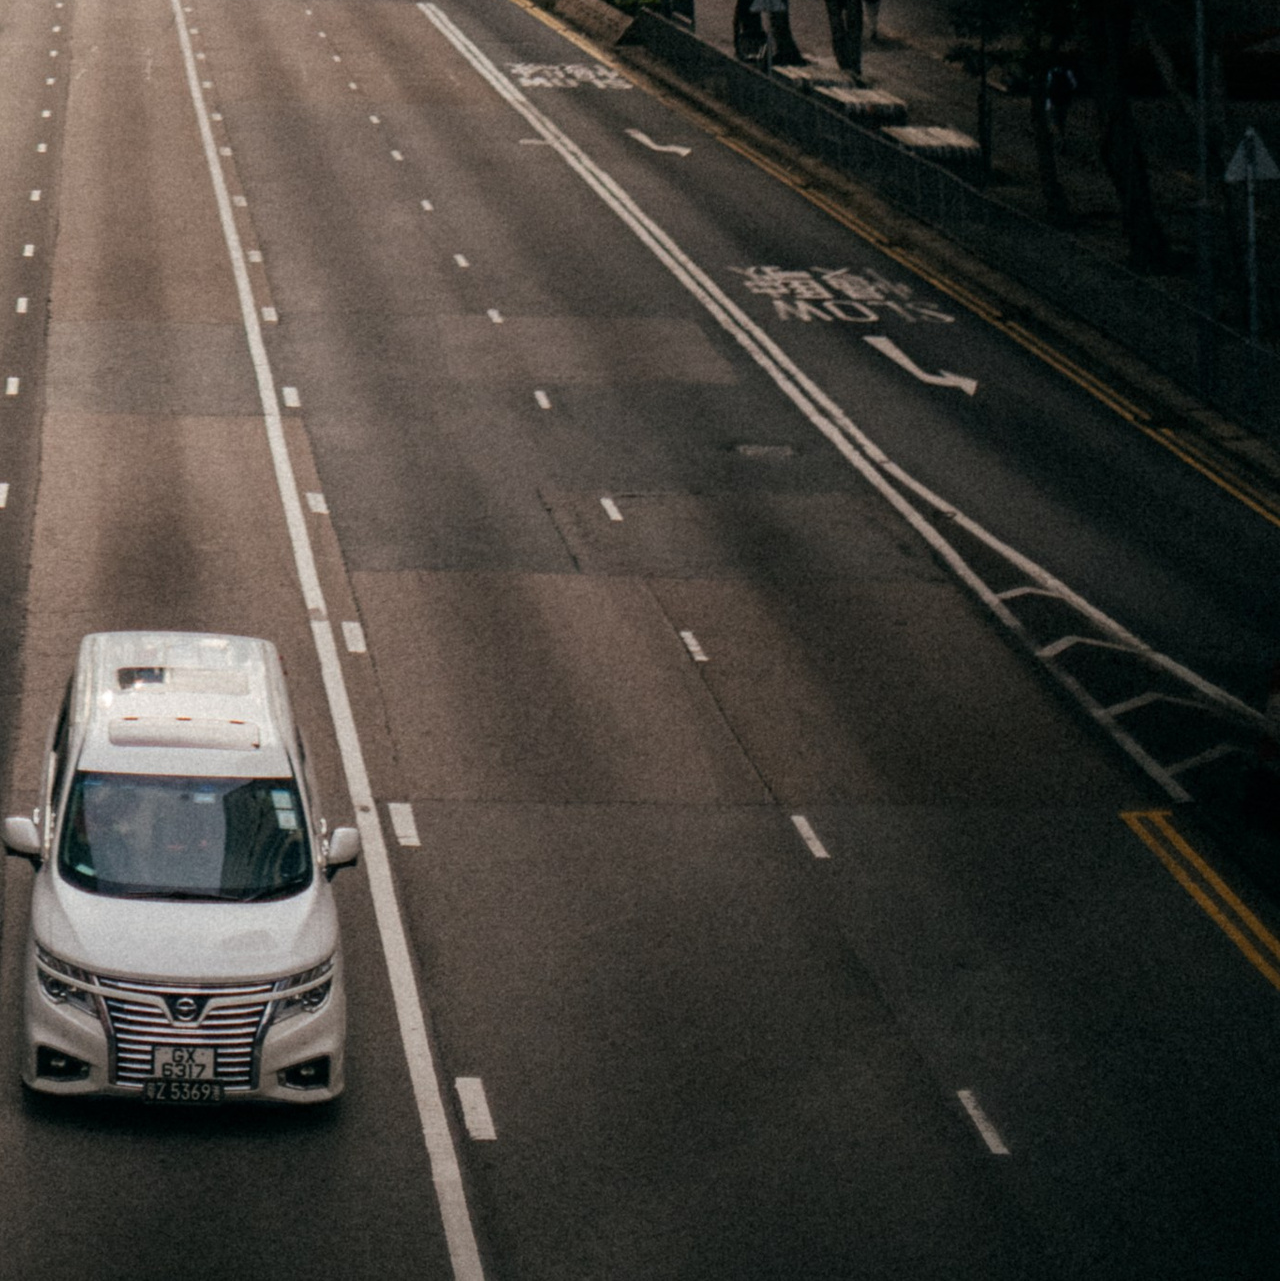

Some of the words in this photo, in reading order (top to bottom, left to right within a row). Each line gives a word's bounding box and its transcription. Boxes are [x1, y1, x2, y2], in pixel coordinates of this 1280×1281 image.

[772, 299, 956, 323] SLOW
[172, 1048, 196, 1063] GX
[162, 1063, 207, 1079] 6317
